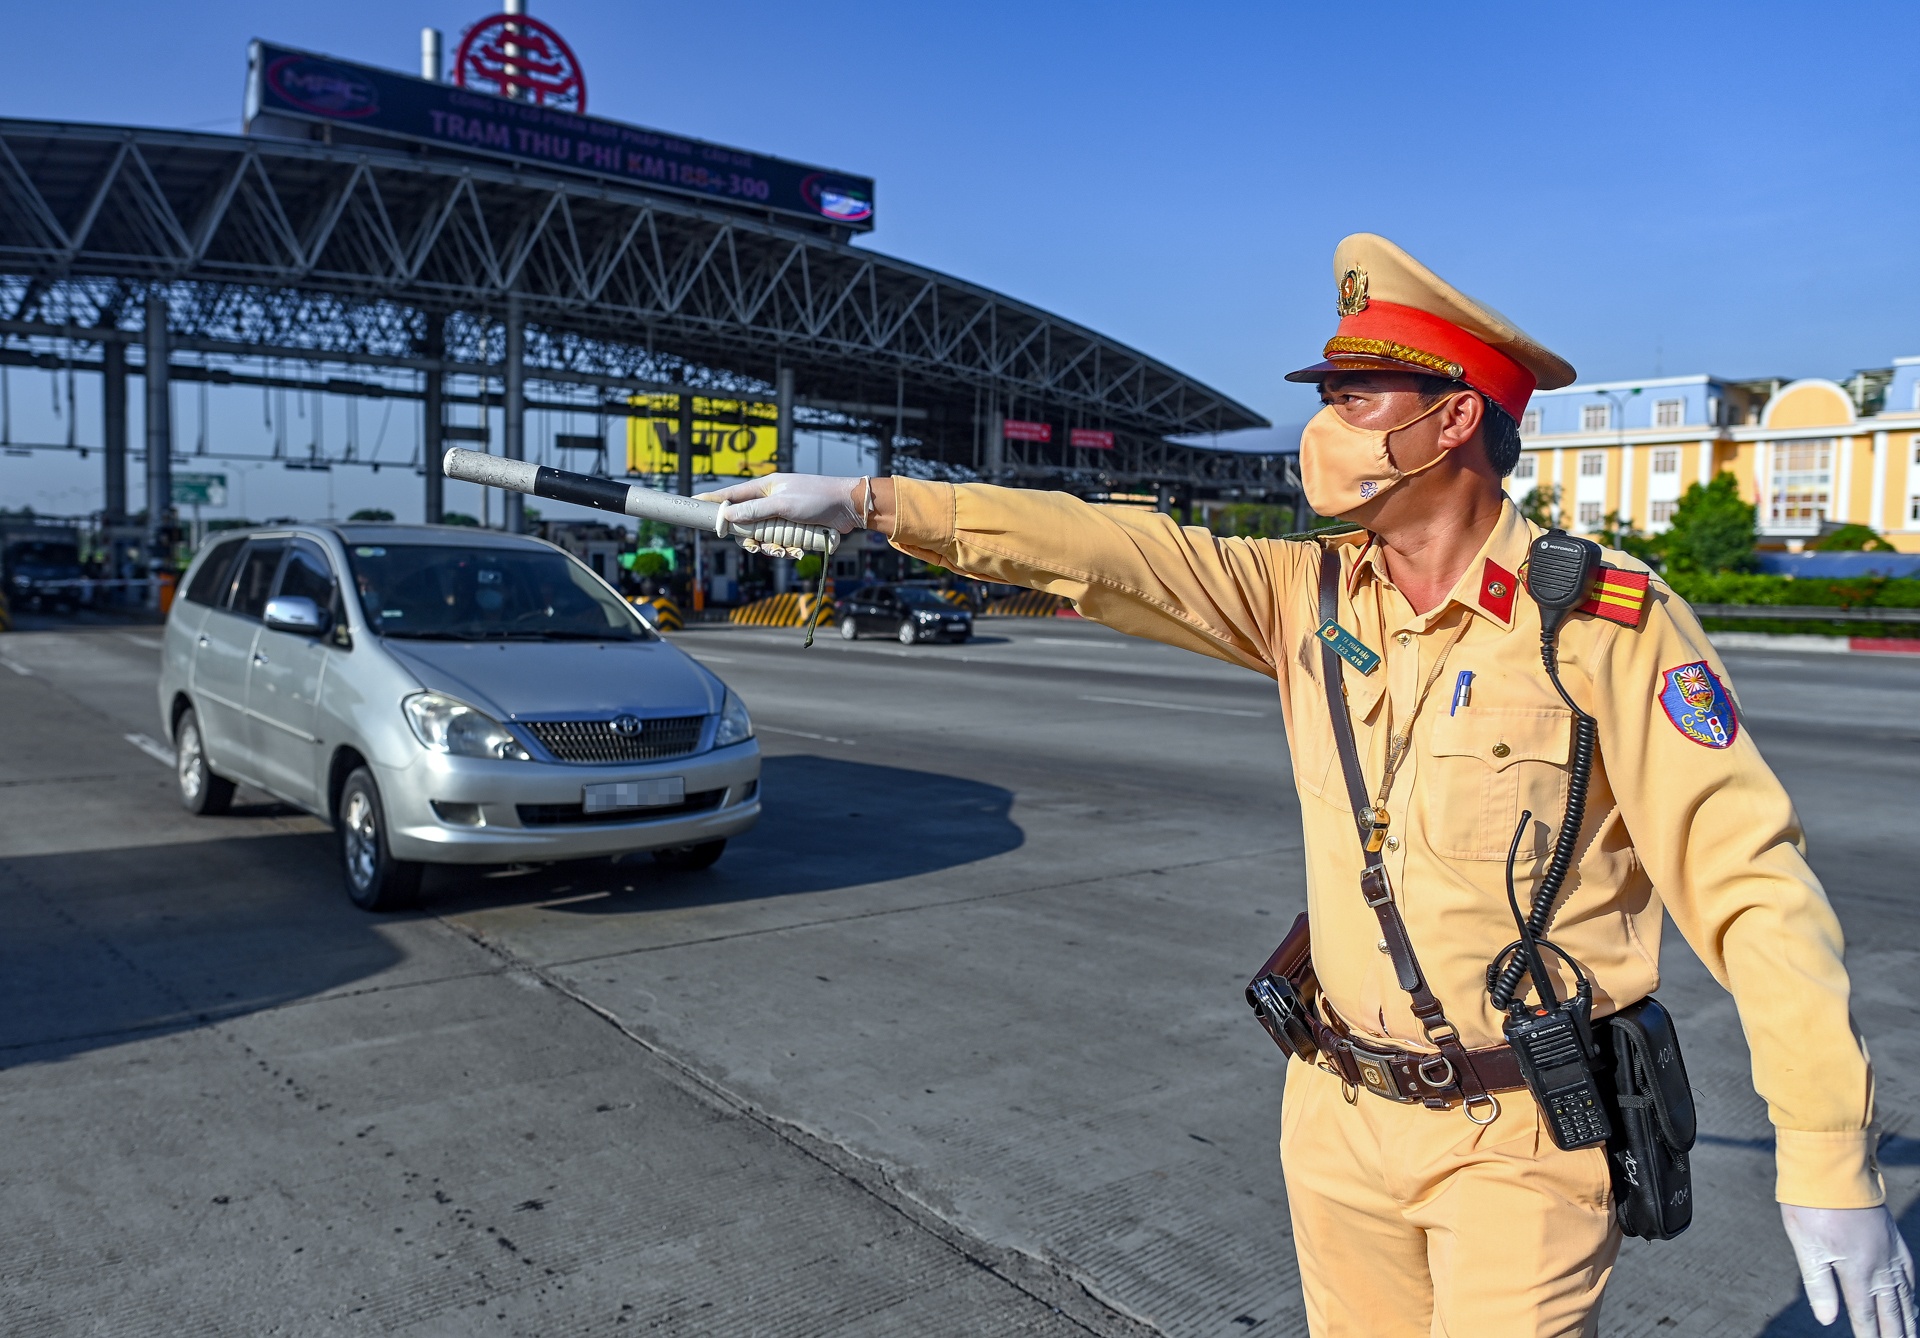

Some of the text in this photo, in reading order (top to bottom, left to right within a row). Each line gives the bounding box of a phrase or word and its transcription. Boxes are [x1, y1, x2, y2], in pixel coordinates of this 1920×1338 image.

[515, 127, 570, 160] THU
[576, 140, 621, 171] PHÍ
[1549, 544, 1578, 553] MOTOROLA
[1337, 644, 1349, 655] 123
[1350, 655, 1363, 667] 416
[1538, 1024, 1566, 1036] MOTOROLA
